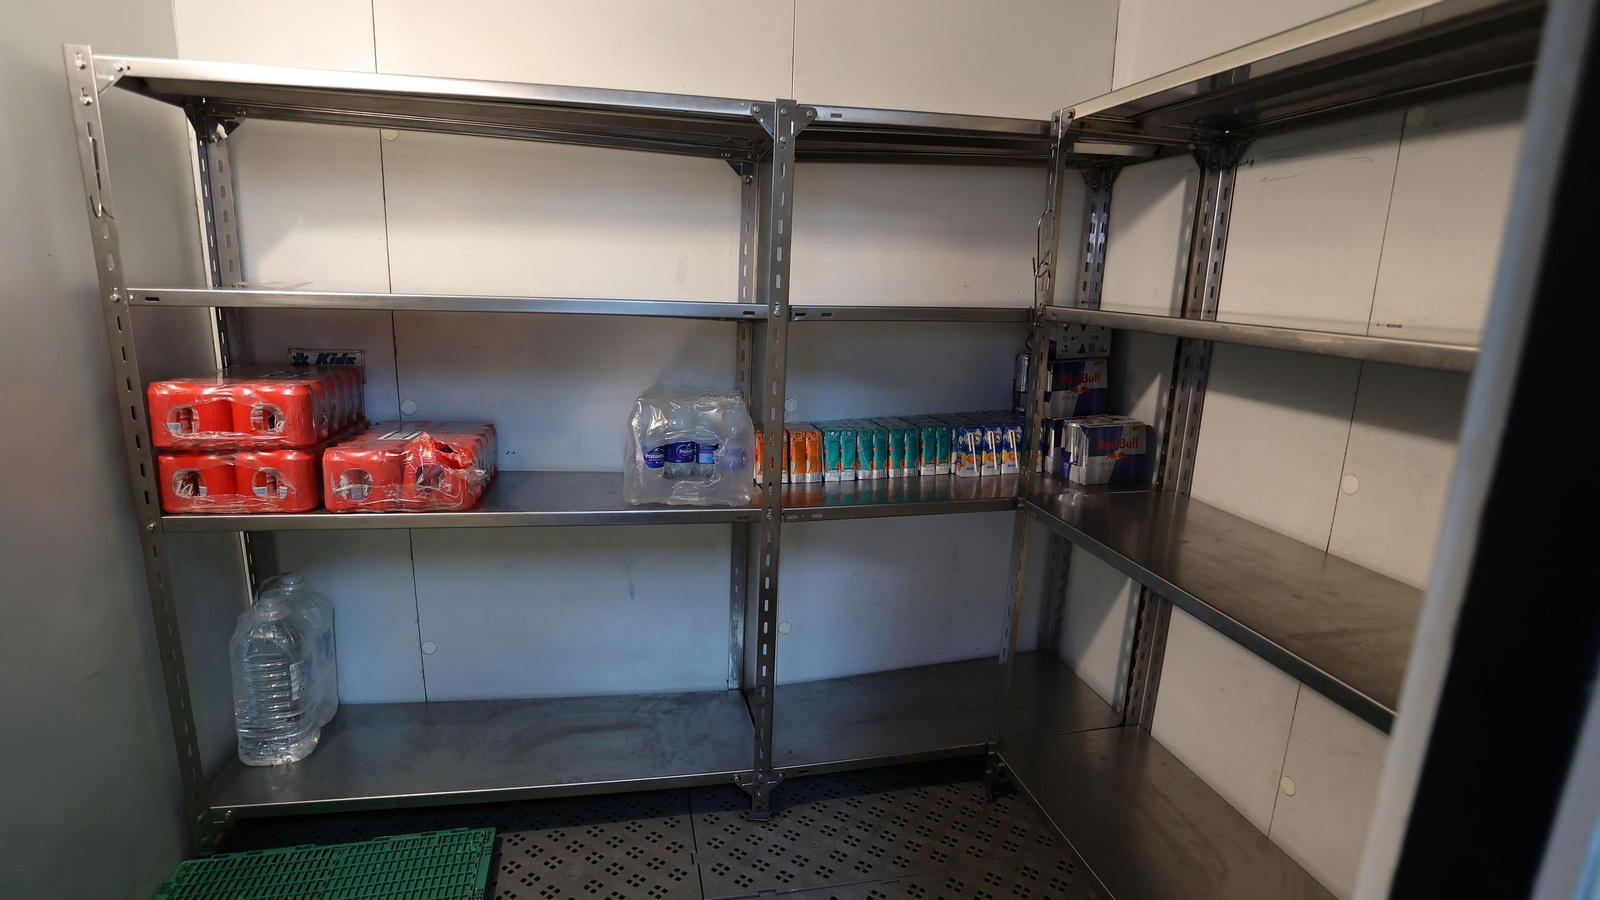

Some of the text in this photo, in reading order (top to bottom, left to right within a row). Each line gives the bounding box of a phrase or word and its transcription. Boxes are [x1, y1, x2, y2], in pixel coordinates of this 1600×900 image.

[1061, 372, 1100, 384] Red Bull
[1097, 437, 1138, 450] Red Bull
